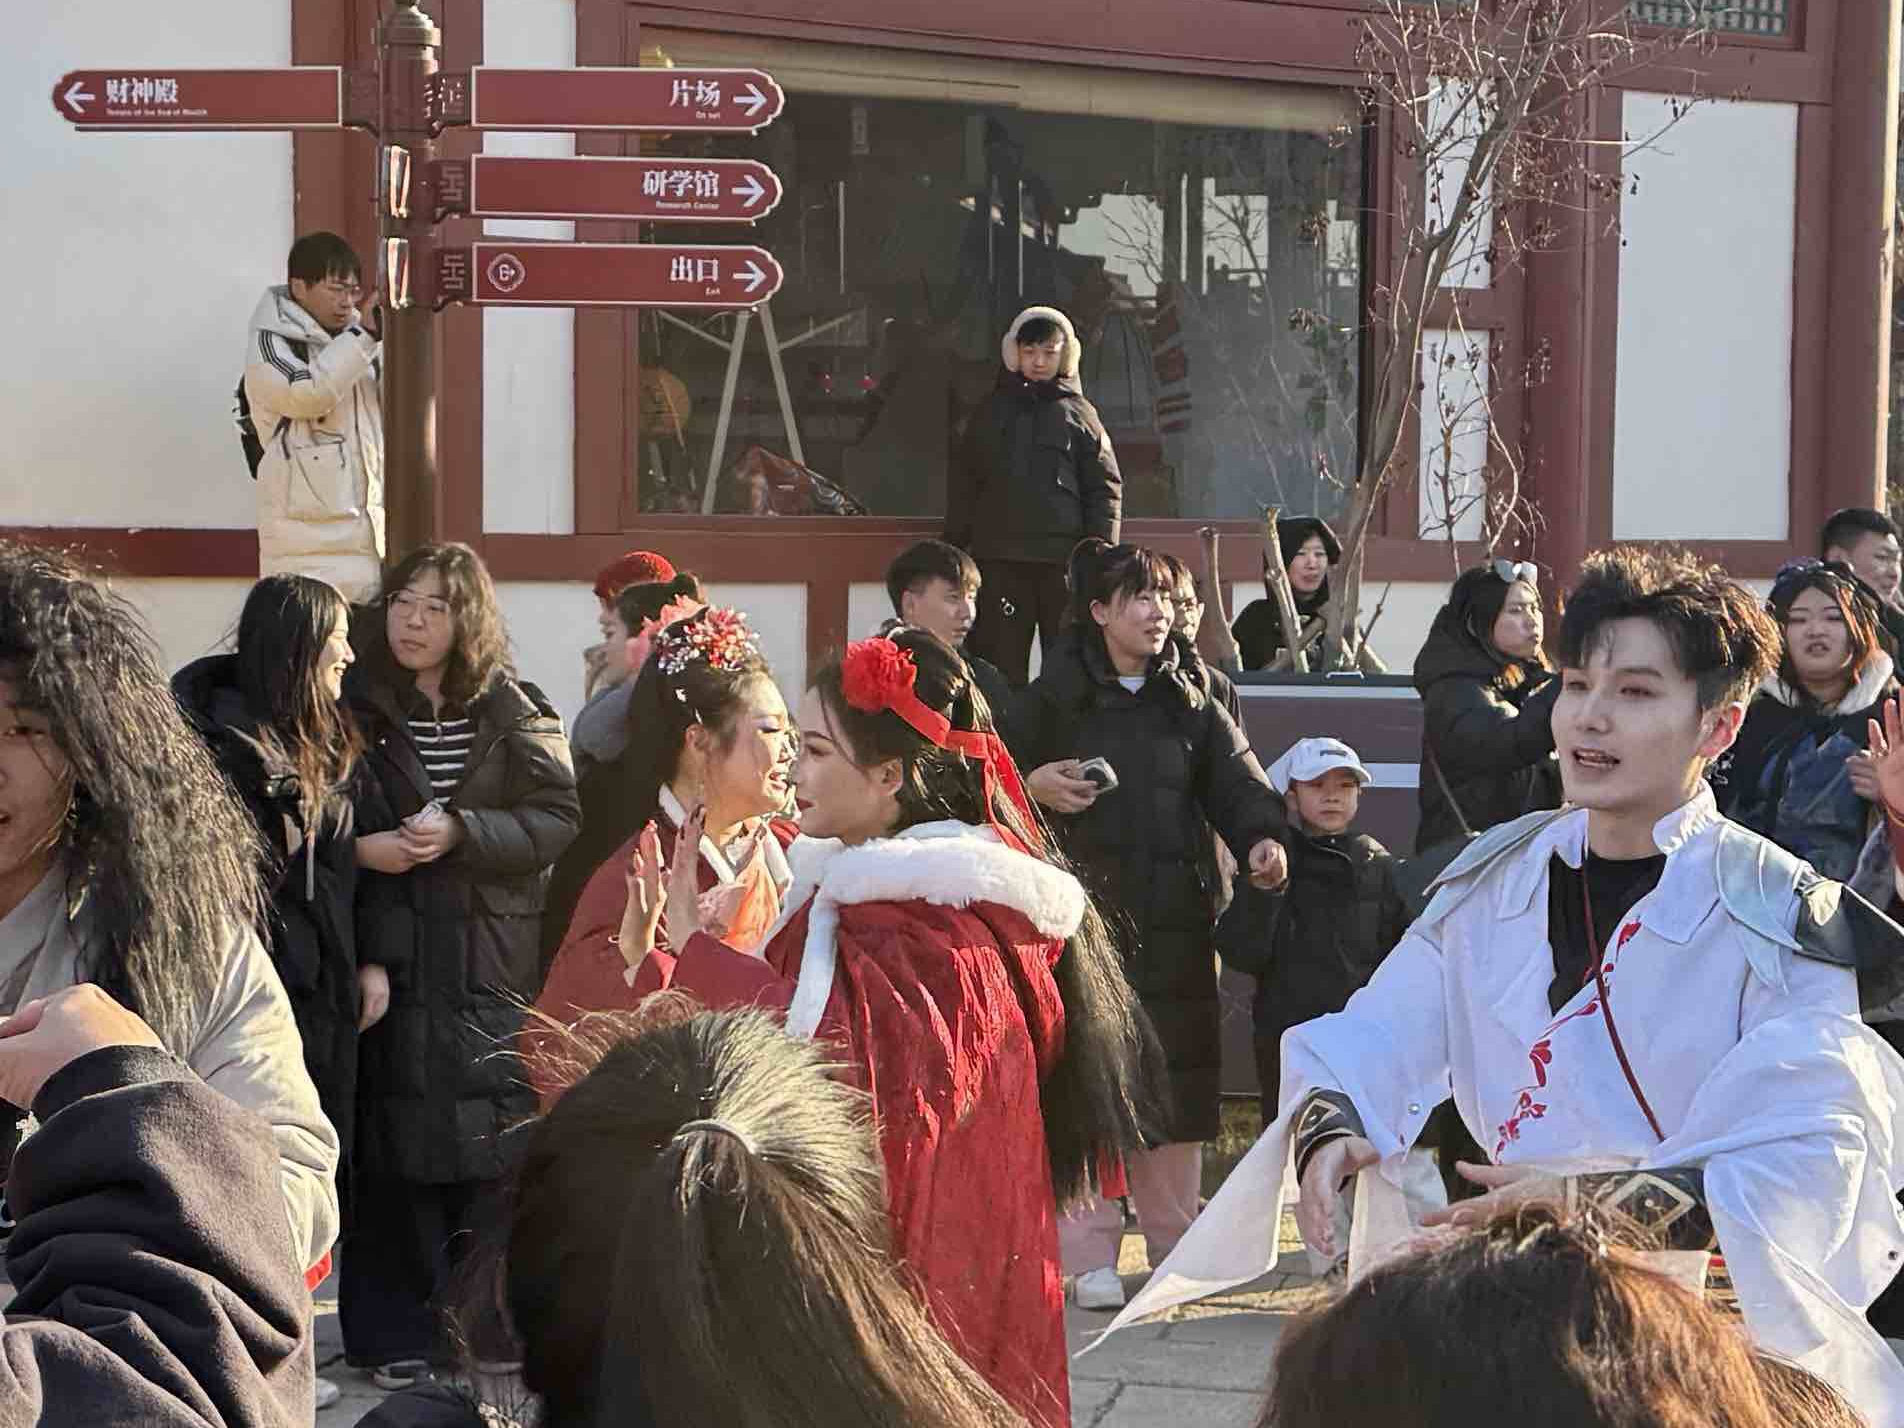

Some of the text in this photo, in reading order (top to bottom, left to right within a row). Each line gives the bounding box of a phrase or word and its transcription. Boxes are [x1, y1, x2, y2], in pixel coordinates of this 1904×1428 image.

[106, 77, 178, 104] 财神殿
[669, 79, 720, 107] 片场
[642, 170, 720, 197] 研学馆
[670, 256, 719, 282] 出口
